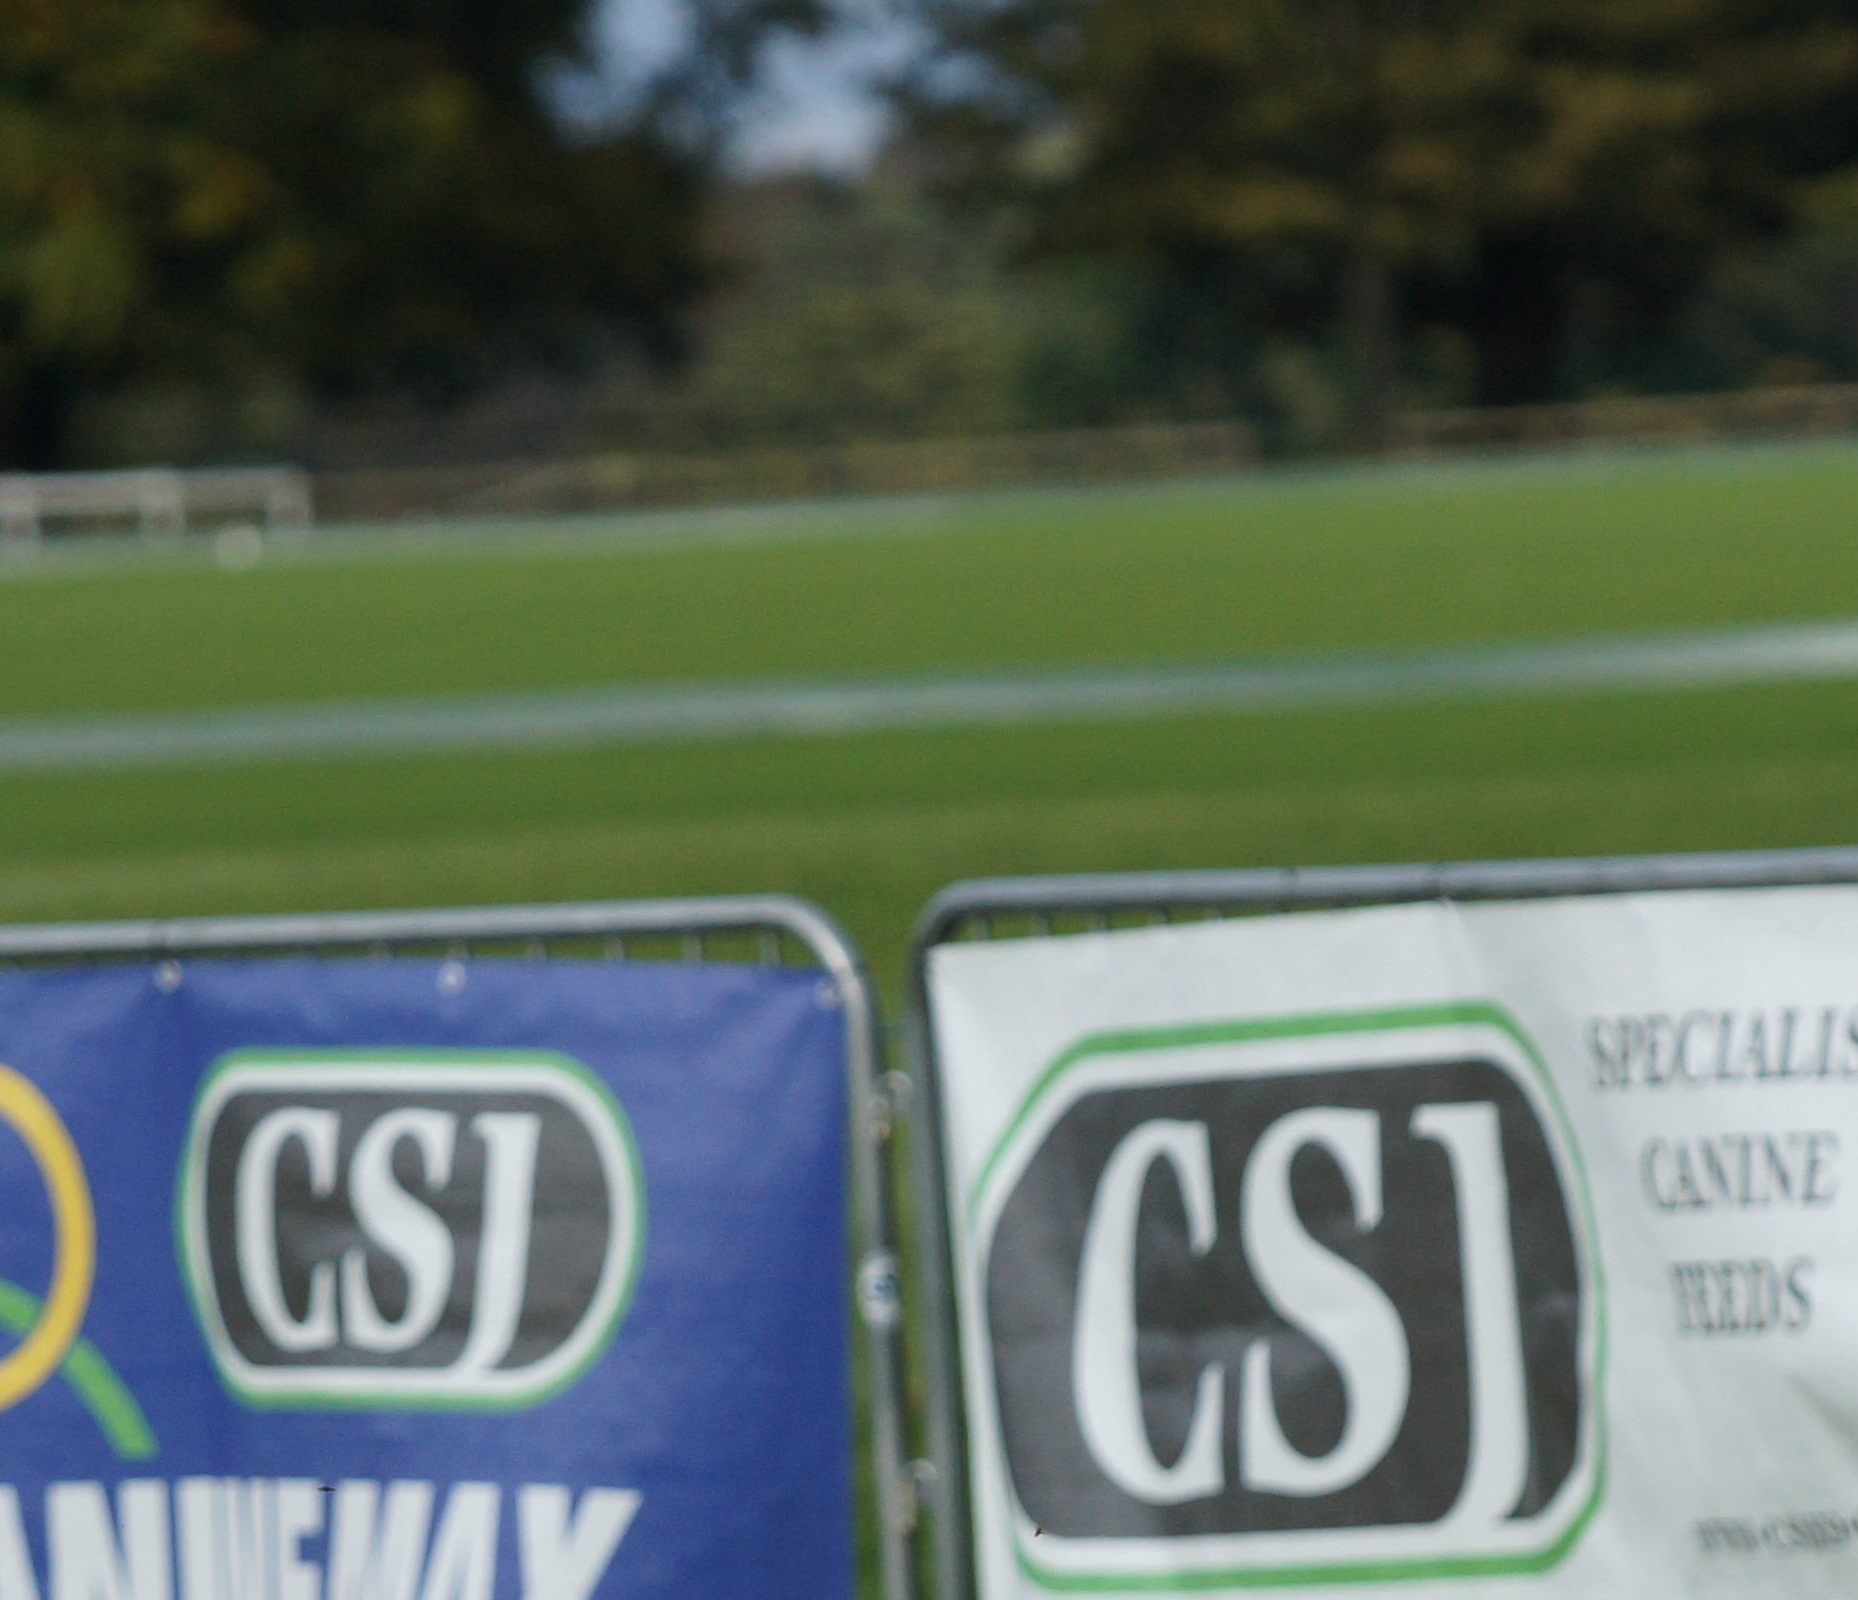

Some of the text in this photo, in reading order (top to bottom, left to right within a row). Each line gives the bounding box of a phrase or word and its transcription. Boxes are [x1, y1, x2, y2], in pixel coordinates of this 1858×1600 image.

[235, 1104, 542, 1376] CSJ
[1638, 1129, 1841, 1213] CANINE
[1072, 1102, 1533, 1526] CSJ
